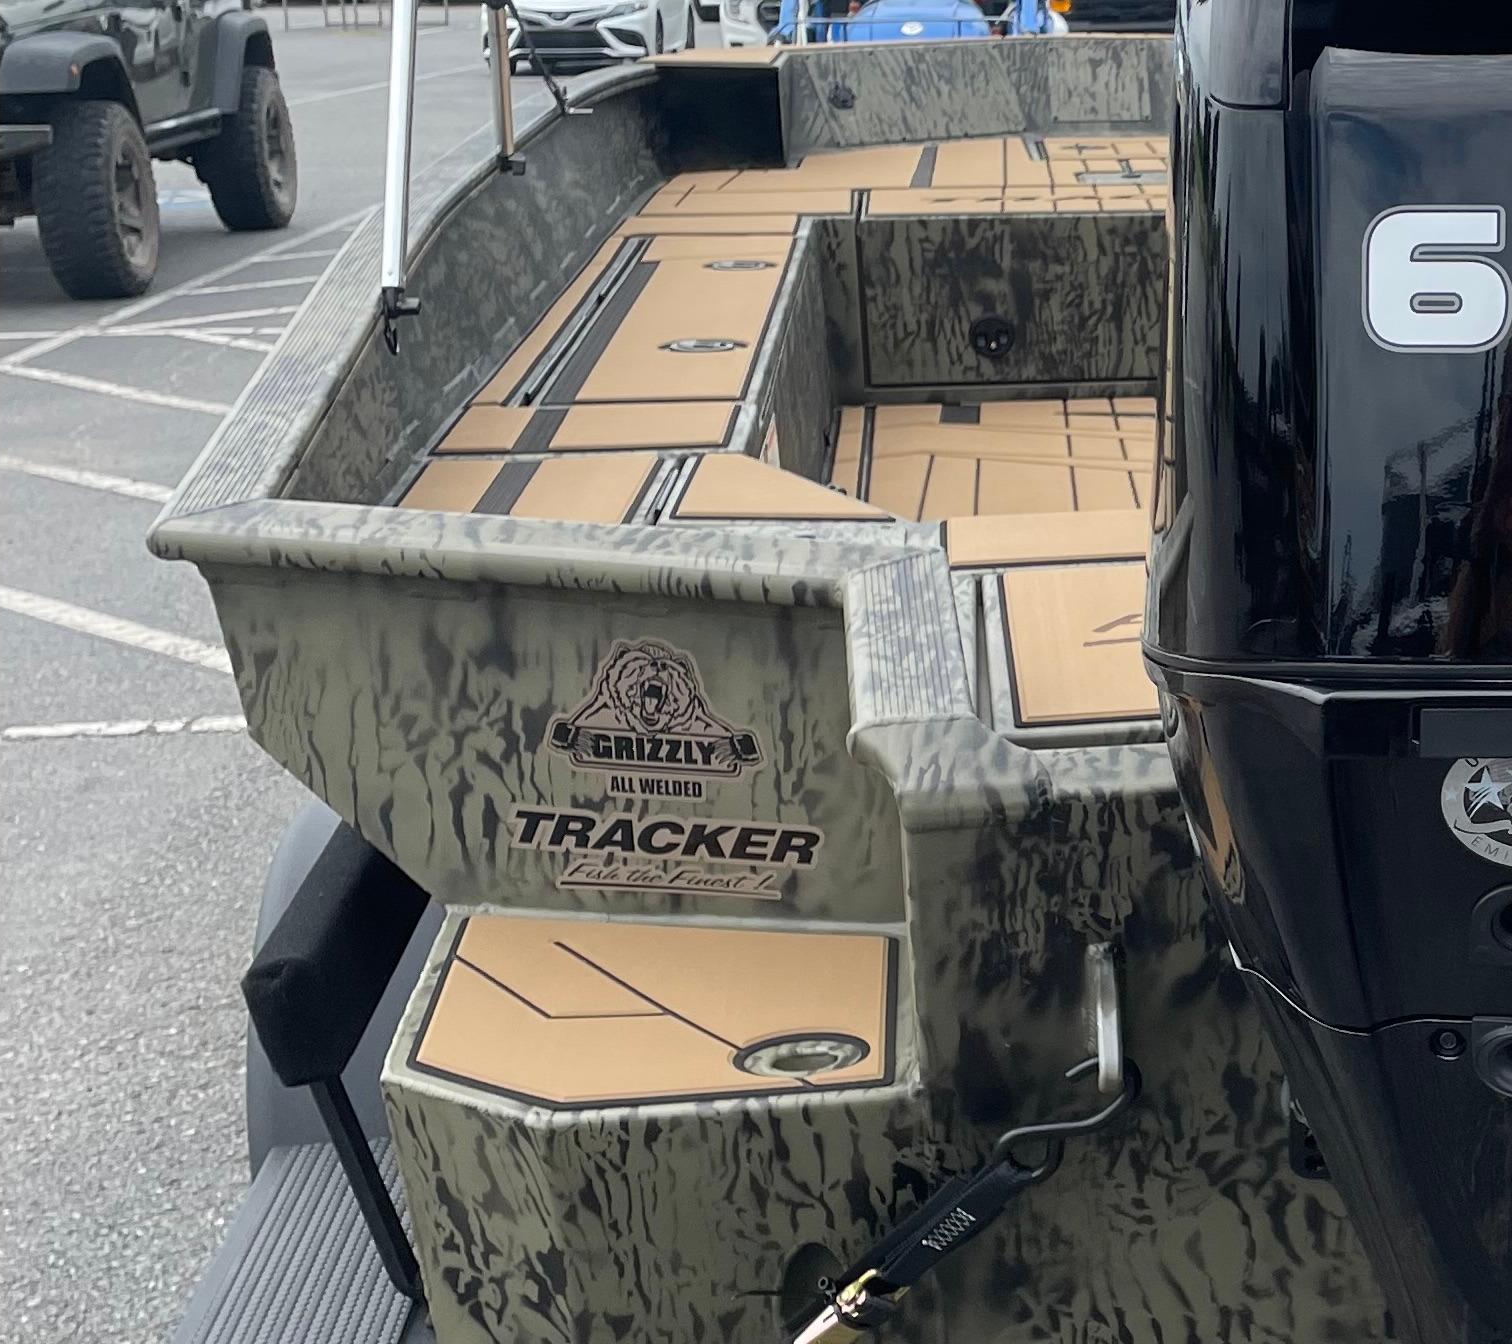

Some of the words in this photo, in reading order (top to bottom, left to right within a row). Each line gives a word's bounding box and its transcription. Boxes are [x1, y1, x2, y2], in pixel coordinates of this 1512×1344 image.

[593, 735, 716, 766] GRIZZLY
[610, 775, 636, 794] ALL
[640, 779, 703, 798] WELDED
[515, 810, 820, 865] TRACKER
[567, 863, 620, 882] Fish
[626, 866, 661, 884] the
